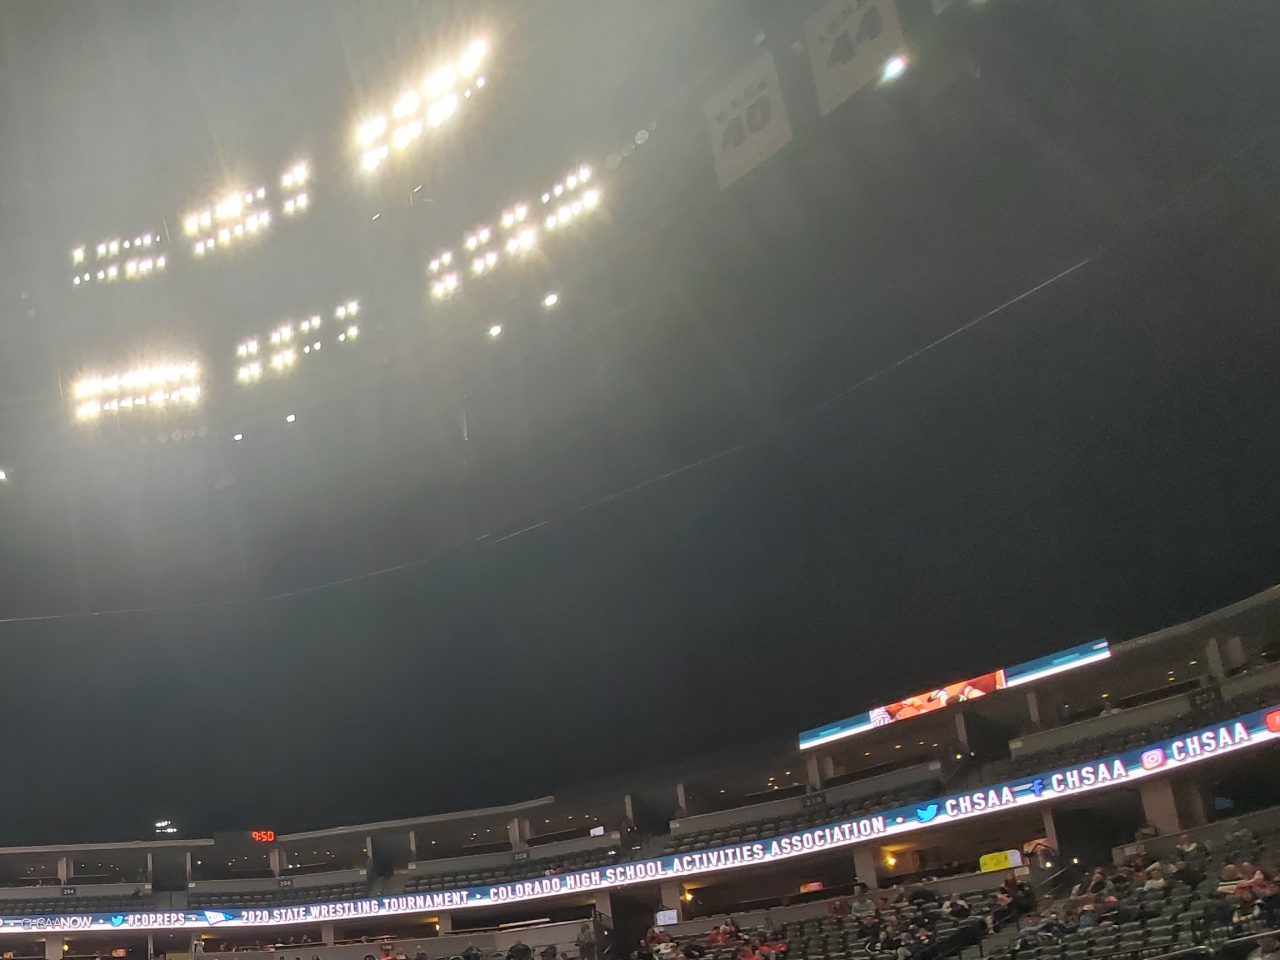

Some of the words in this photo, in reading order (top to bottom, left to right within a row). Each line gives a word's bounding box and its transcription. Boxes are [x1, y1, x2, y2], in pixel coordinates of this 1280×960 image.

[1169, 721, 1251, 762] CHSAA
[1051, 759, 1128, 793] CHSAA
[944, 785, 1015, 818] CHSAA
[251, 830, 275, 842] 9:50
[489, 877, 561, 902] COLORADO
[566, 870, 602, 890] HIGH
[606, 859, 668, 885] SCHOOL
[671, 845, 764, 873] ACTIVITIES
[769, 815, 885, 858] ASSOCIATION
[127, 912, 186, 927] #COPREPS
[241, 910, 269, 924] 2020
[273, 907, 307, 922] STATE
[310, 900, 380, 919] WRESTLING
[382, 891, 469, 912] TOURNAMENT
